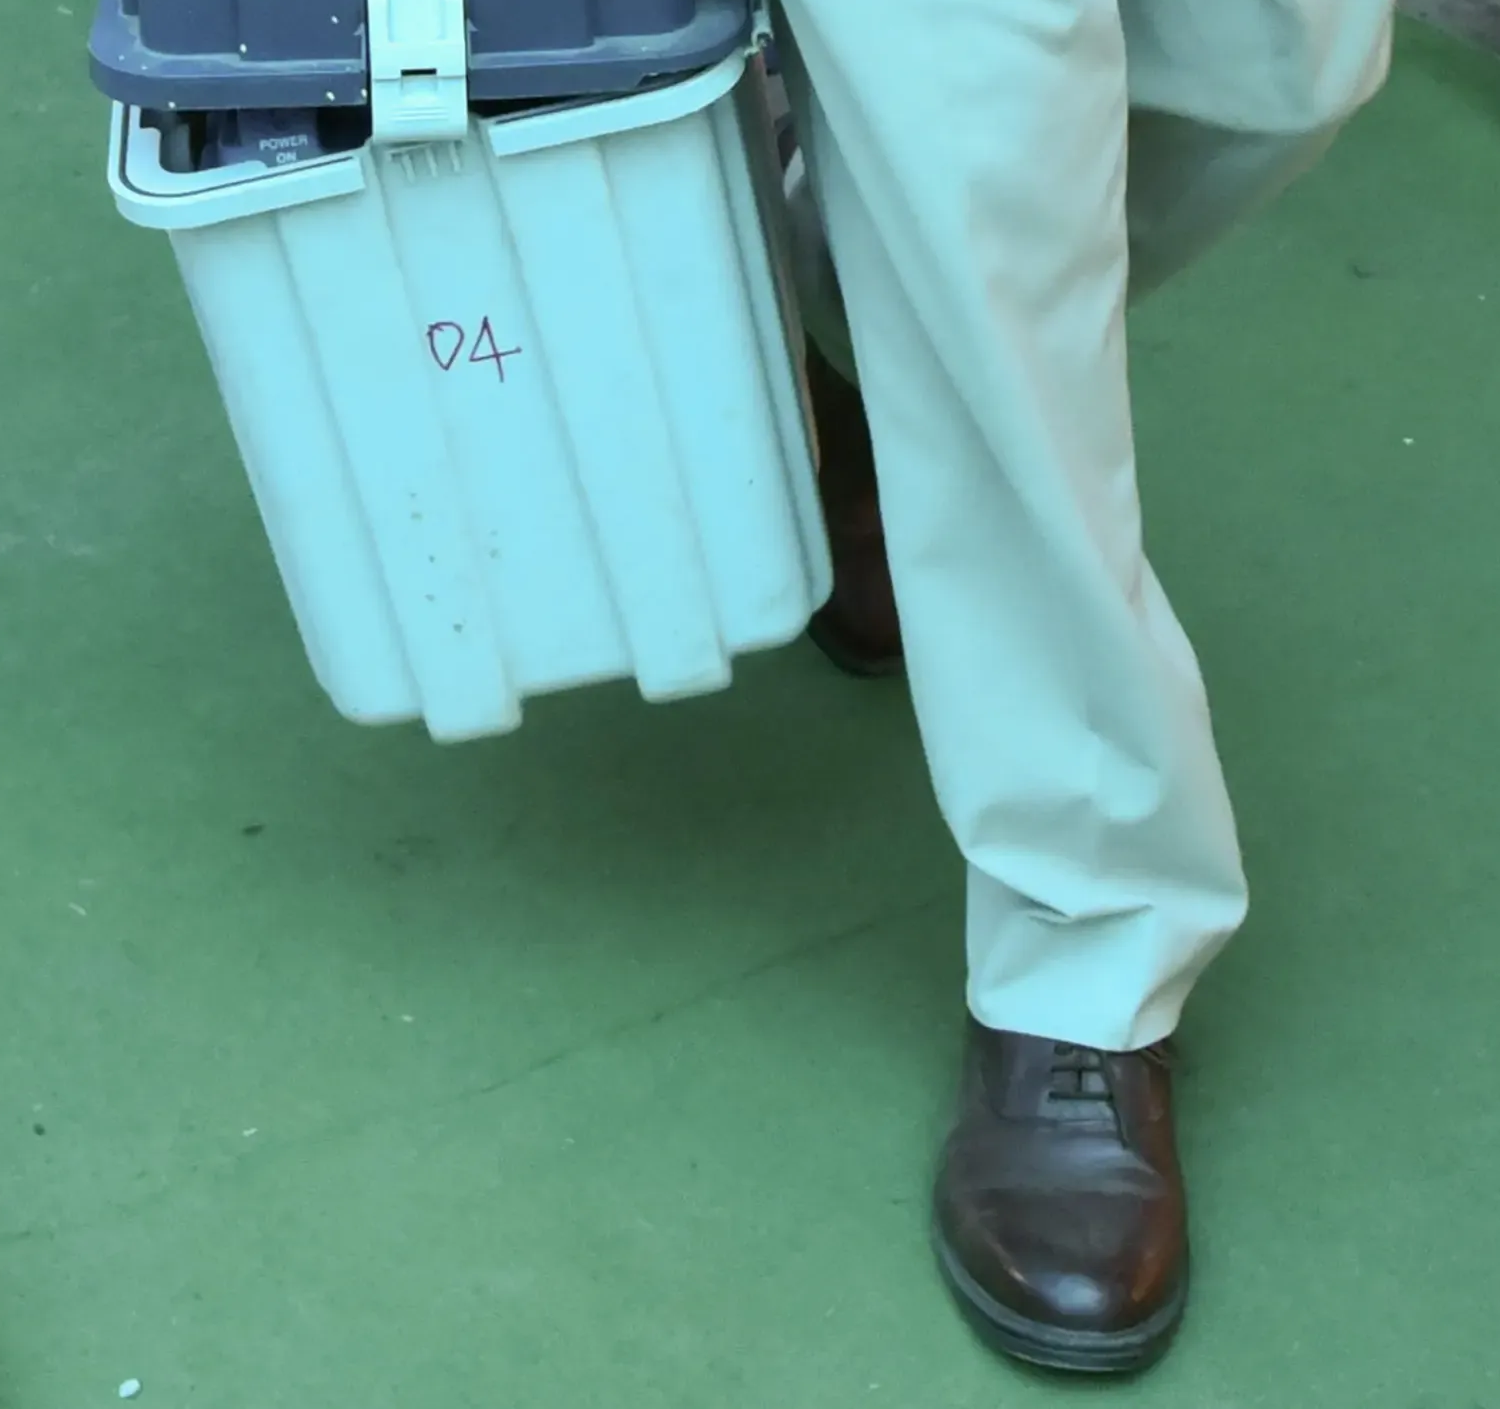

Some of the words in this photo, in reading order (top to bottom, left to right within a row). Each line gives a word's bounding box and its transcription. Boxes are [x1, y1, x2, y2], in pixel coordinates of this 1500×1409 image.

[259, 133, 309, 151] POWER
[276, 151, 297, 164] ON
[426, 315, 523, 383] 04
